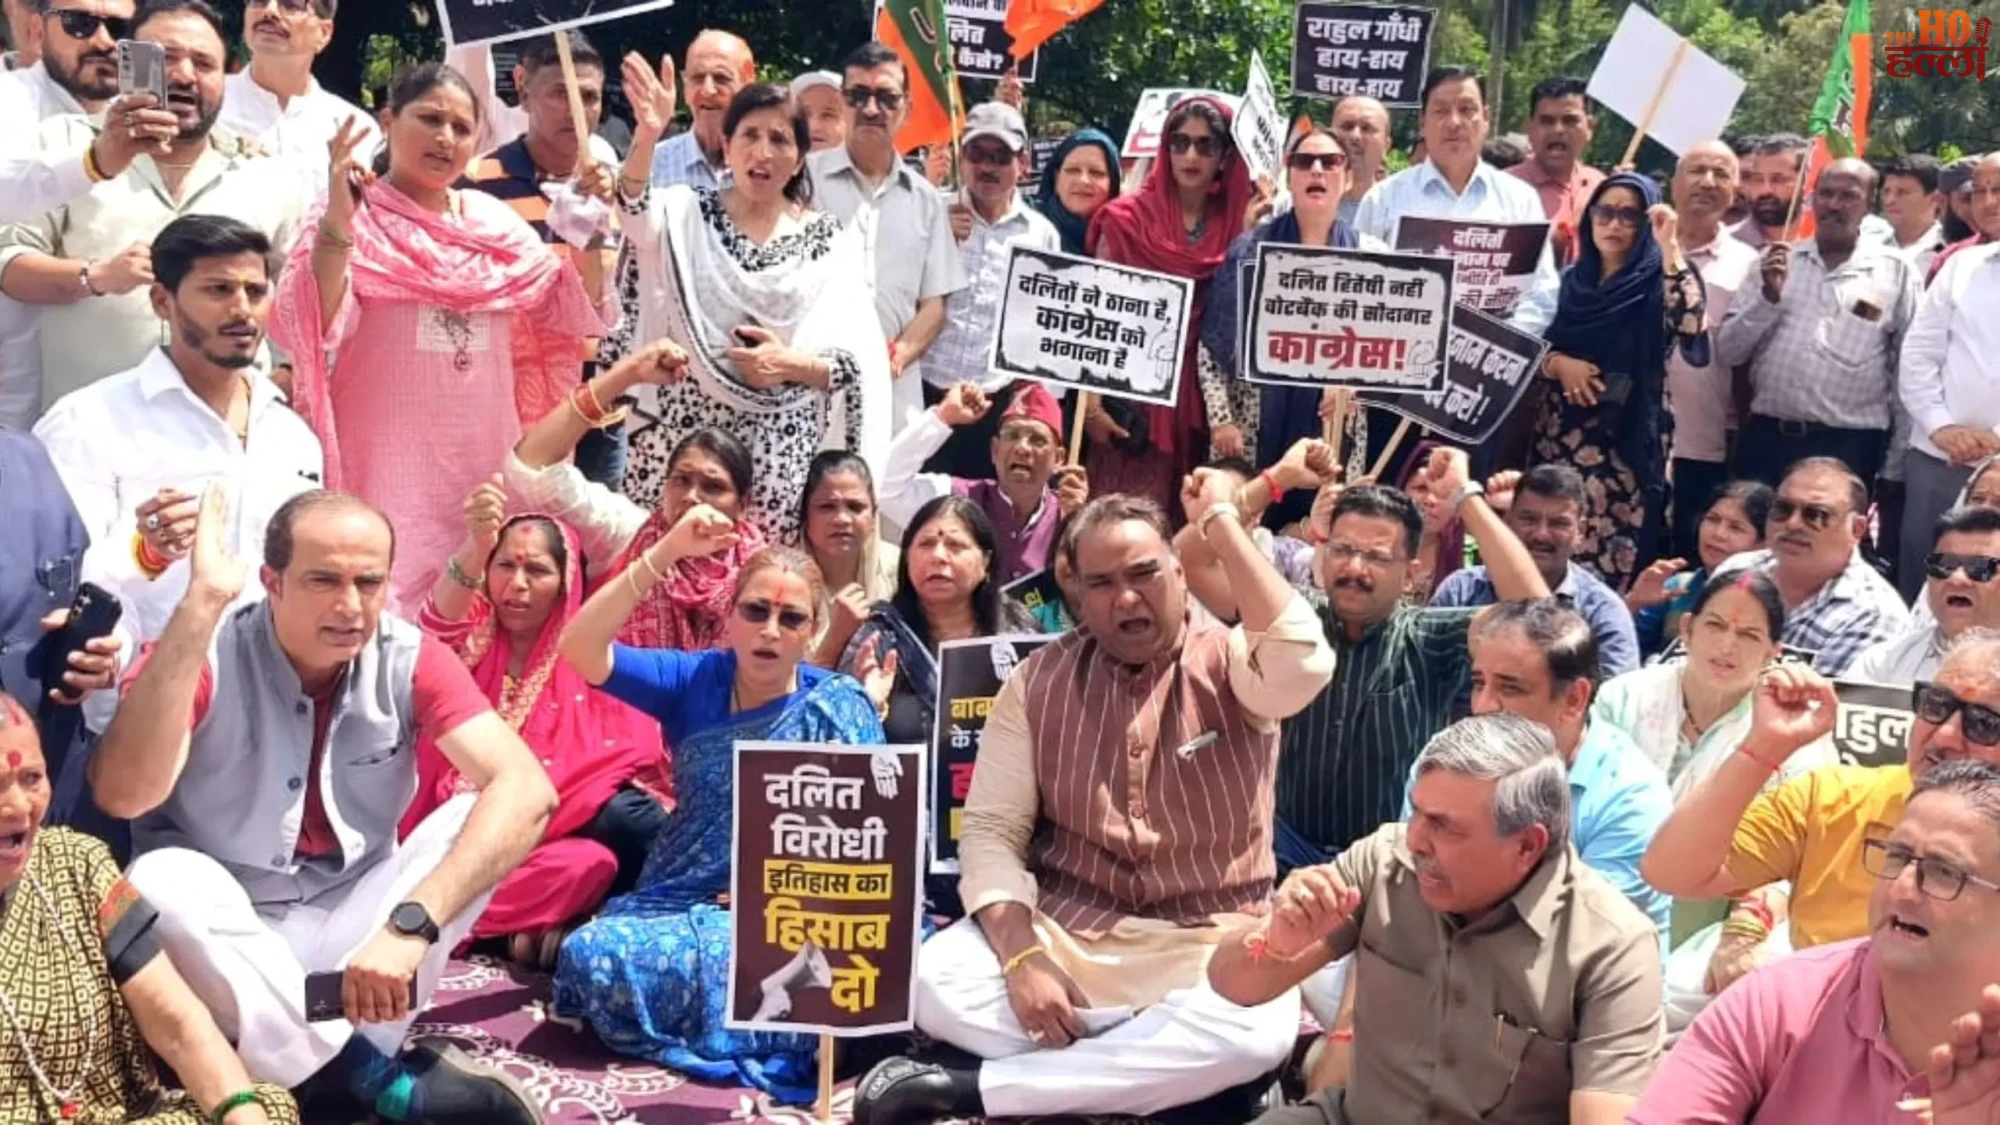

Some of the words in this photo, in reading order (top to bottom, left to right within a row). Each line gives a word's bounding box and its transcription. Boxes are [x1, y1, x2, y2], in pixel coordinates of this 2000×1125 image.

[946, 18, 985, 44] लित
[1306, 16, 1373, 44] राहुल
[1375, 11, 1422, 43] गाँधी
[1314, 46, 1409, 71] हाय-हाय
[1313, 73, 1404, 99] हाय-हाय
[1018, 272, 1079, 303] दलितों
[1082, 284, 1105, 308] ने
[1106, 292, 1149, 318] ठाना
[1154, 298, 1172, 324] है,
[1278, 268, 1329, 292] दलित
[1389, 278, 1429, 299] नहीं
[1036, 303, 1120, 343] कांग्रेस
[1121, 325, 1147, 349] को
[1333, 299, 1359, 321] की
[1362, 301, 1434, 326] सौदागर
[1041, 337, 1110, 366] भगाना
[1114, 347, 1129, 369] है
[1266, 322, 1408, 371] कांग्रेस!
[1836, 703, 1916, 754] ाहुल
[762, 763, 865, 810] दलित
[769, 813, 888, 861] विरोधी
[767, 863, 851, 894] इतिहास
[855, 872, 888, 894] का
[763, 896, 891, 952] हिसाब
[830, 953, 880, 1013] दो
